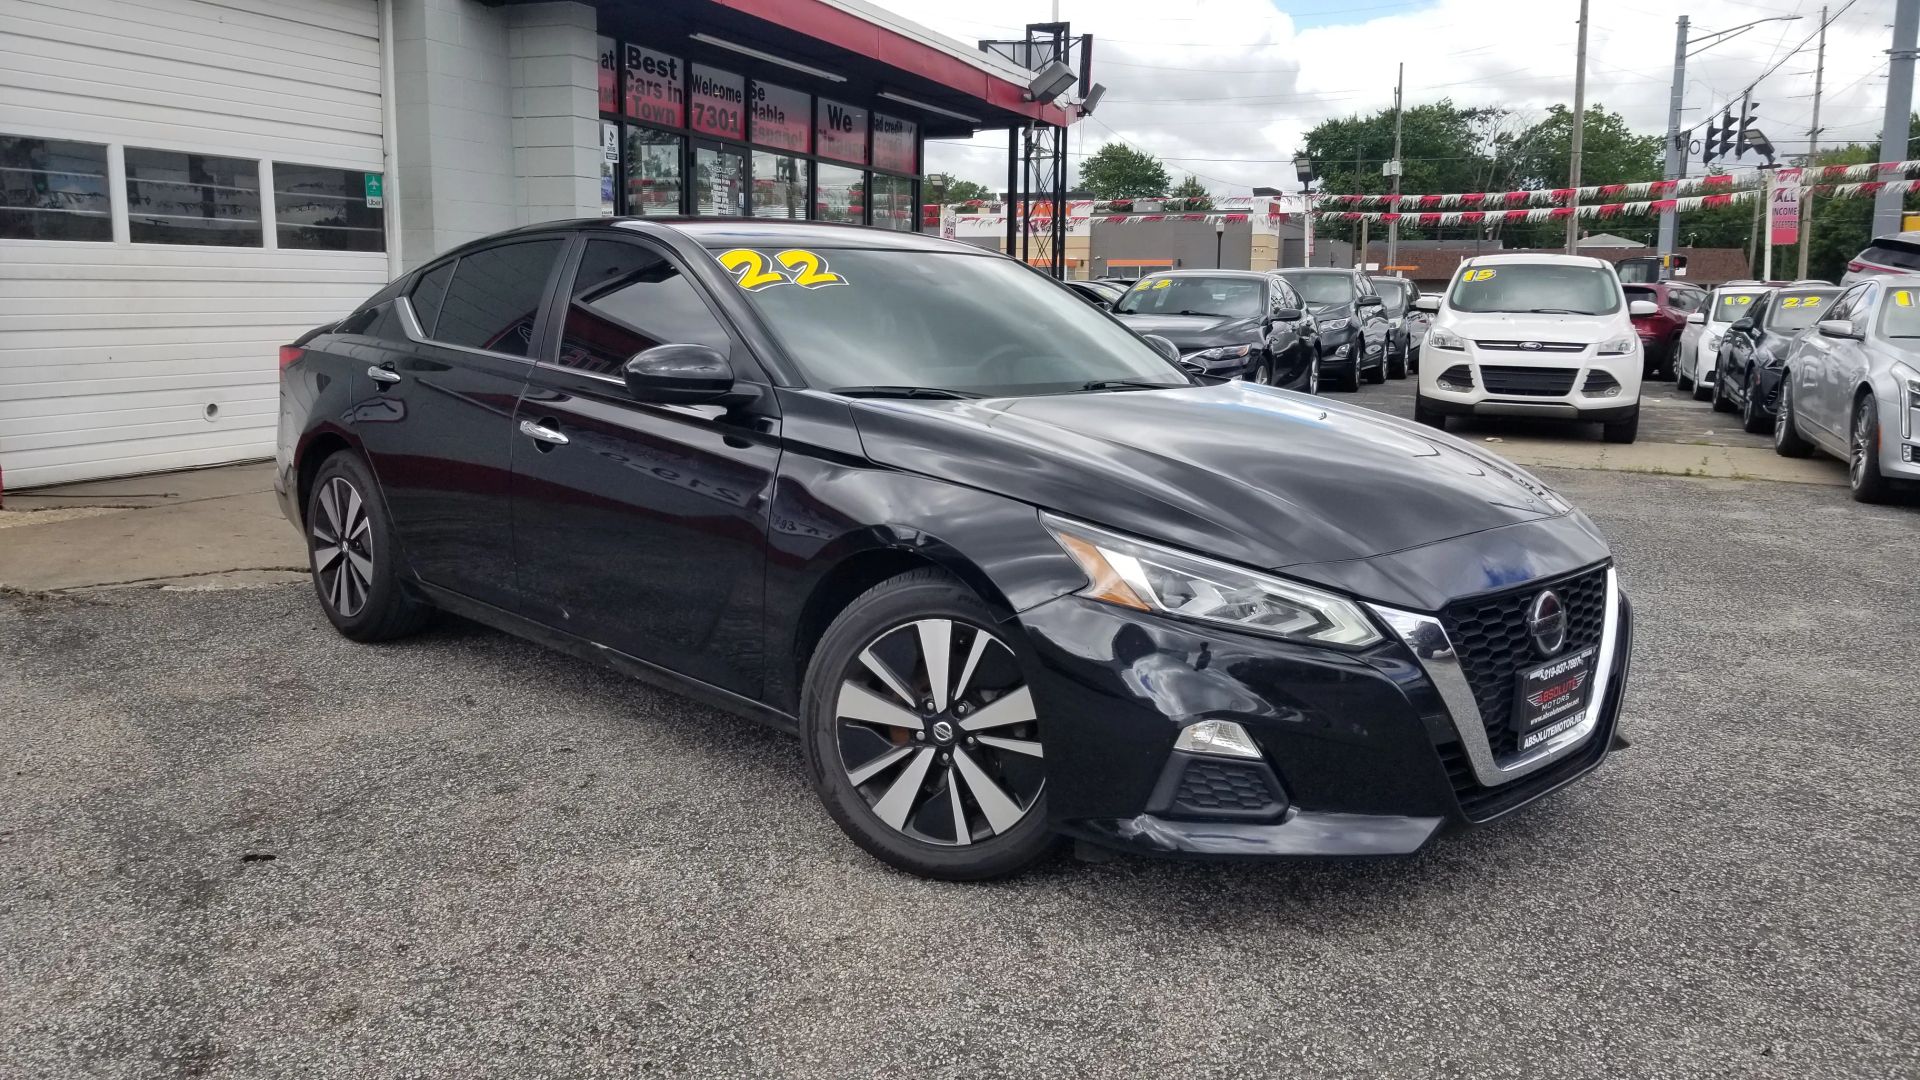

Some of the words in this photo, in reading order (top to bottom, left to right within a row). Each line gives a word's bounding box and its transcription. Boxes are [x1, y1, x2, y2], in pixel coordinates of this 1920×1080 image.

[627, 46, 677, 80] Best
[625, 69, 662, 99] Cars
[667, 81, 683, 104] in
[691, 74, 742, 103] Welcome
[632, 94, 676, 123] Town
[694, 102, 739, 132] 7301
[750, 101, 785, 125] Habla
[827, 104, 853, 132] We
[1774, 192, 1797, 202] ALL
[1773, 207, 1797, 216] INCOME
[717, 248, 849, 292] 22
[1782, 295, 1821, 309] 22
[1893, 290, 1920, 309] 1
[1537, 678, 1578, 703] ABSOLUTE
[1541, 693, 1570, 711] MOTORS
[1523, 710, 1586, 749] ABSOLUTEMOTOR.NET
